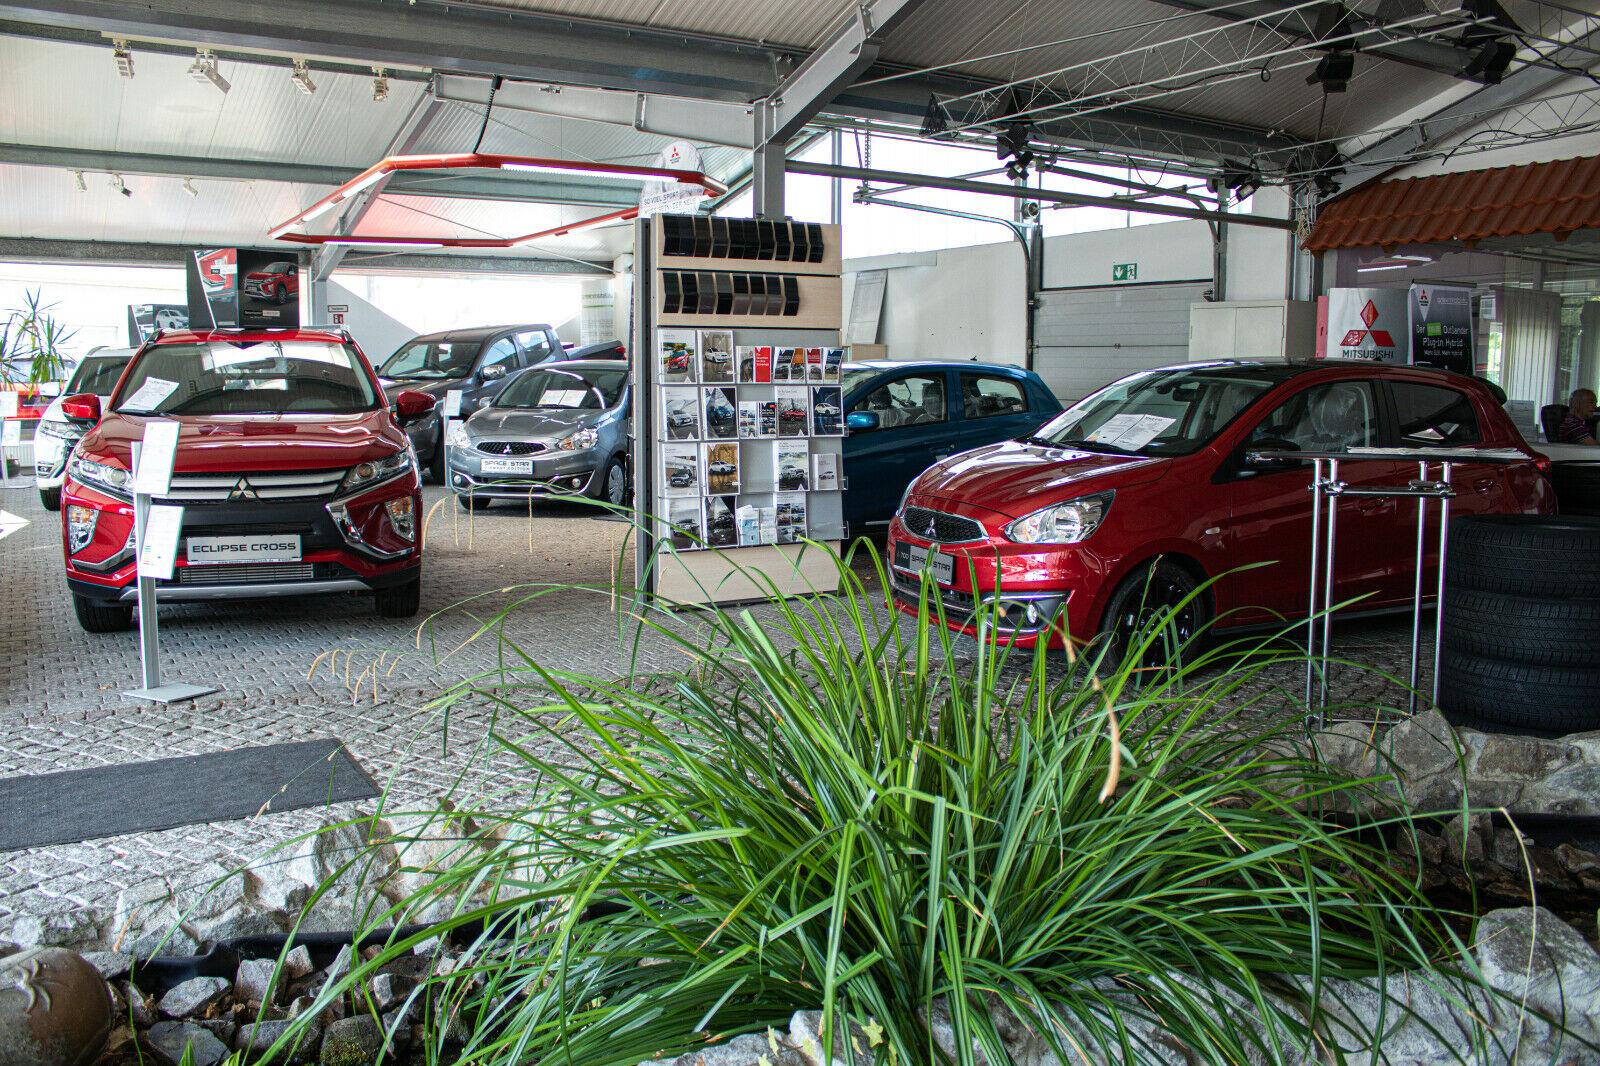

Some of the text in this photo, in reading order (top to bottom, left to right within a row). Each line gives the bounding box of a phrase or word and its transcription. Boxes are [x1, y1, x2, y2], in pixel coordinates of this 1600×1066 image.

[1423, 338, 1463, 348] Plug-in Hybrid
[1342, 349, 1394, 359] MITSUBISHI
[192, 542, 297, 553] ECLIPSE CROSS
[911, 554, 928, 565] SPAC
[932, 561, 951, 572] STAR
